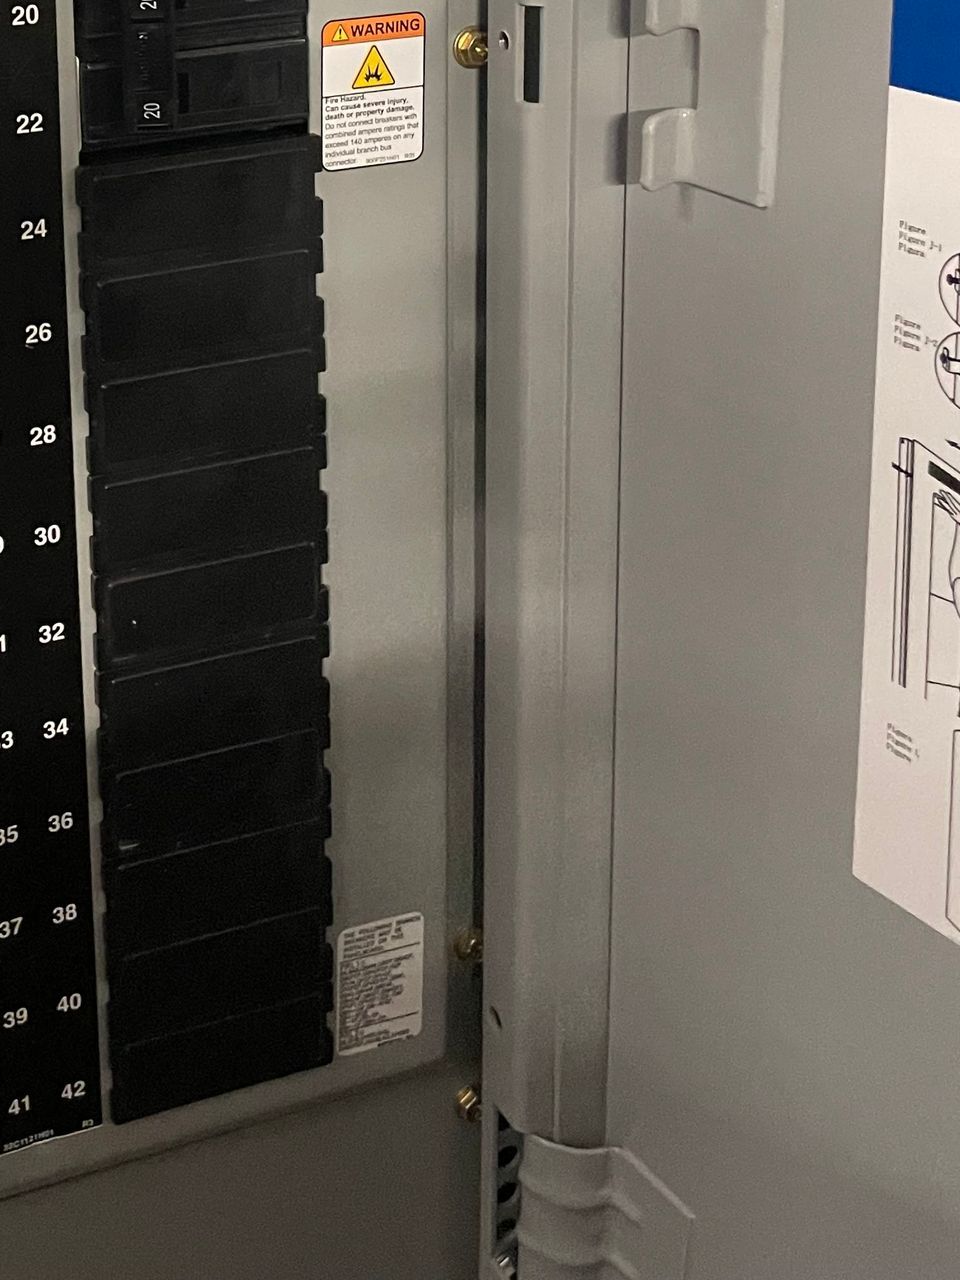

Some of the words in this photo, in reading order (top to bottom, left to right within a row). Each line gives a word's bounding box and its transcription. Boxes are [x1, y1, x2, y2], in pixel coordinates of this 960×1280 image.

[11, 4, 40, 26] 20
[351, 18, 420, 37] WARNING
[143, 102, 161, 120] 20
[325, 112, 344, 120] death
[356, 109, 384, 117] property
[16, 112, 44, 135] 22
[20, 218, 48, 240] 24
[25, 322, 52, 344] 26
[29, 424, 57, 447] 28
[34, 524, 61, 547] 30
[38, 622, 66, 644] 32
[42, 717, 70, 739] 34
[48, 811, 74, 833] 36
[52, 903, 78, 924] 38
[57, 992, 82, 1013] 40
[3, 1007, 28, 1029] 39
[61, 1080, 86, 1100] 42
[8, 1094, 30, 1115] 41
